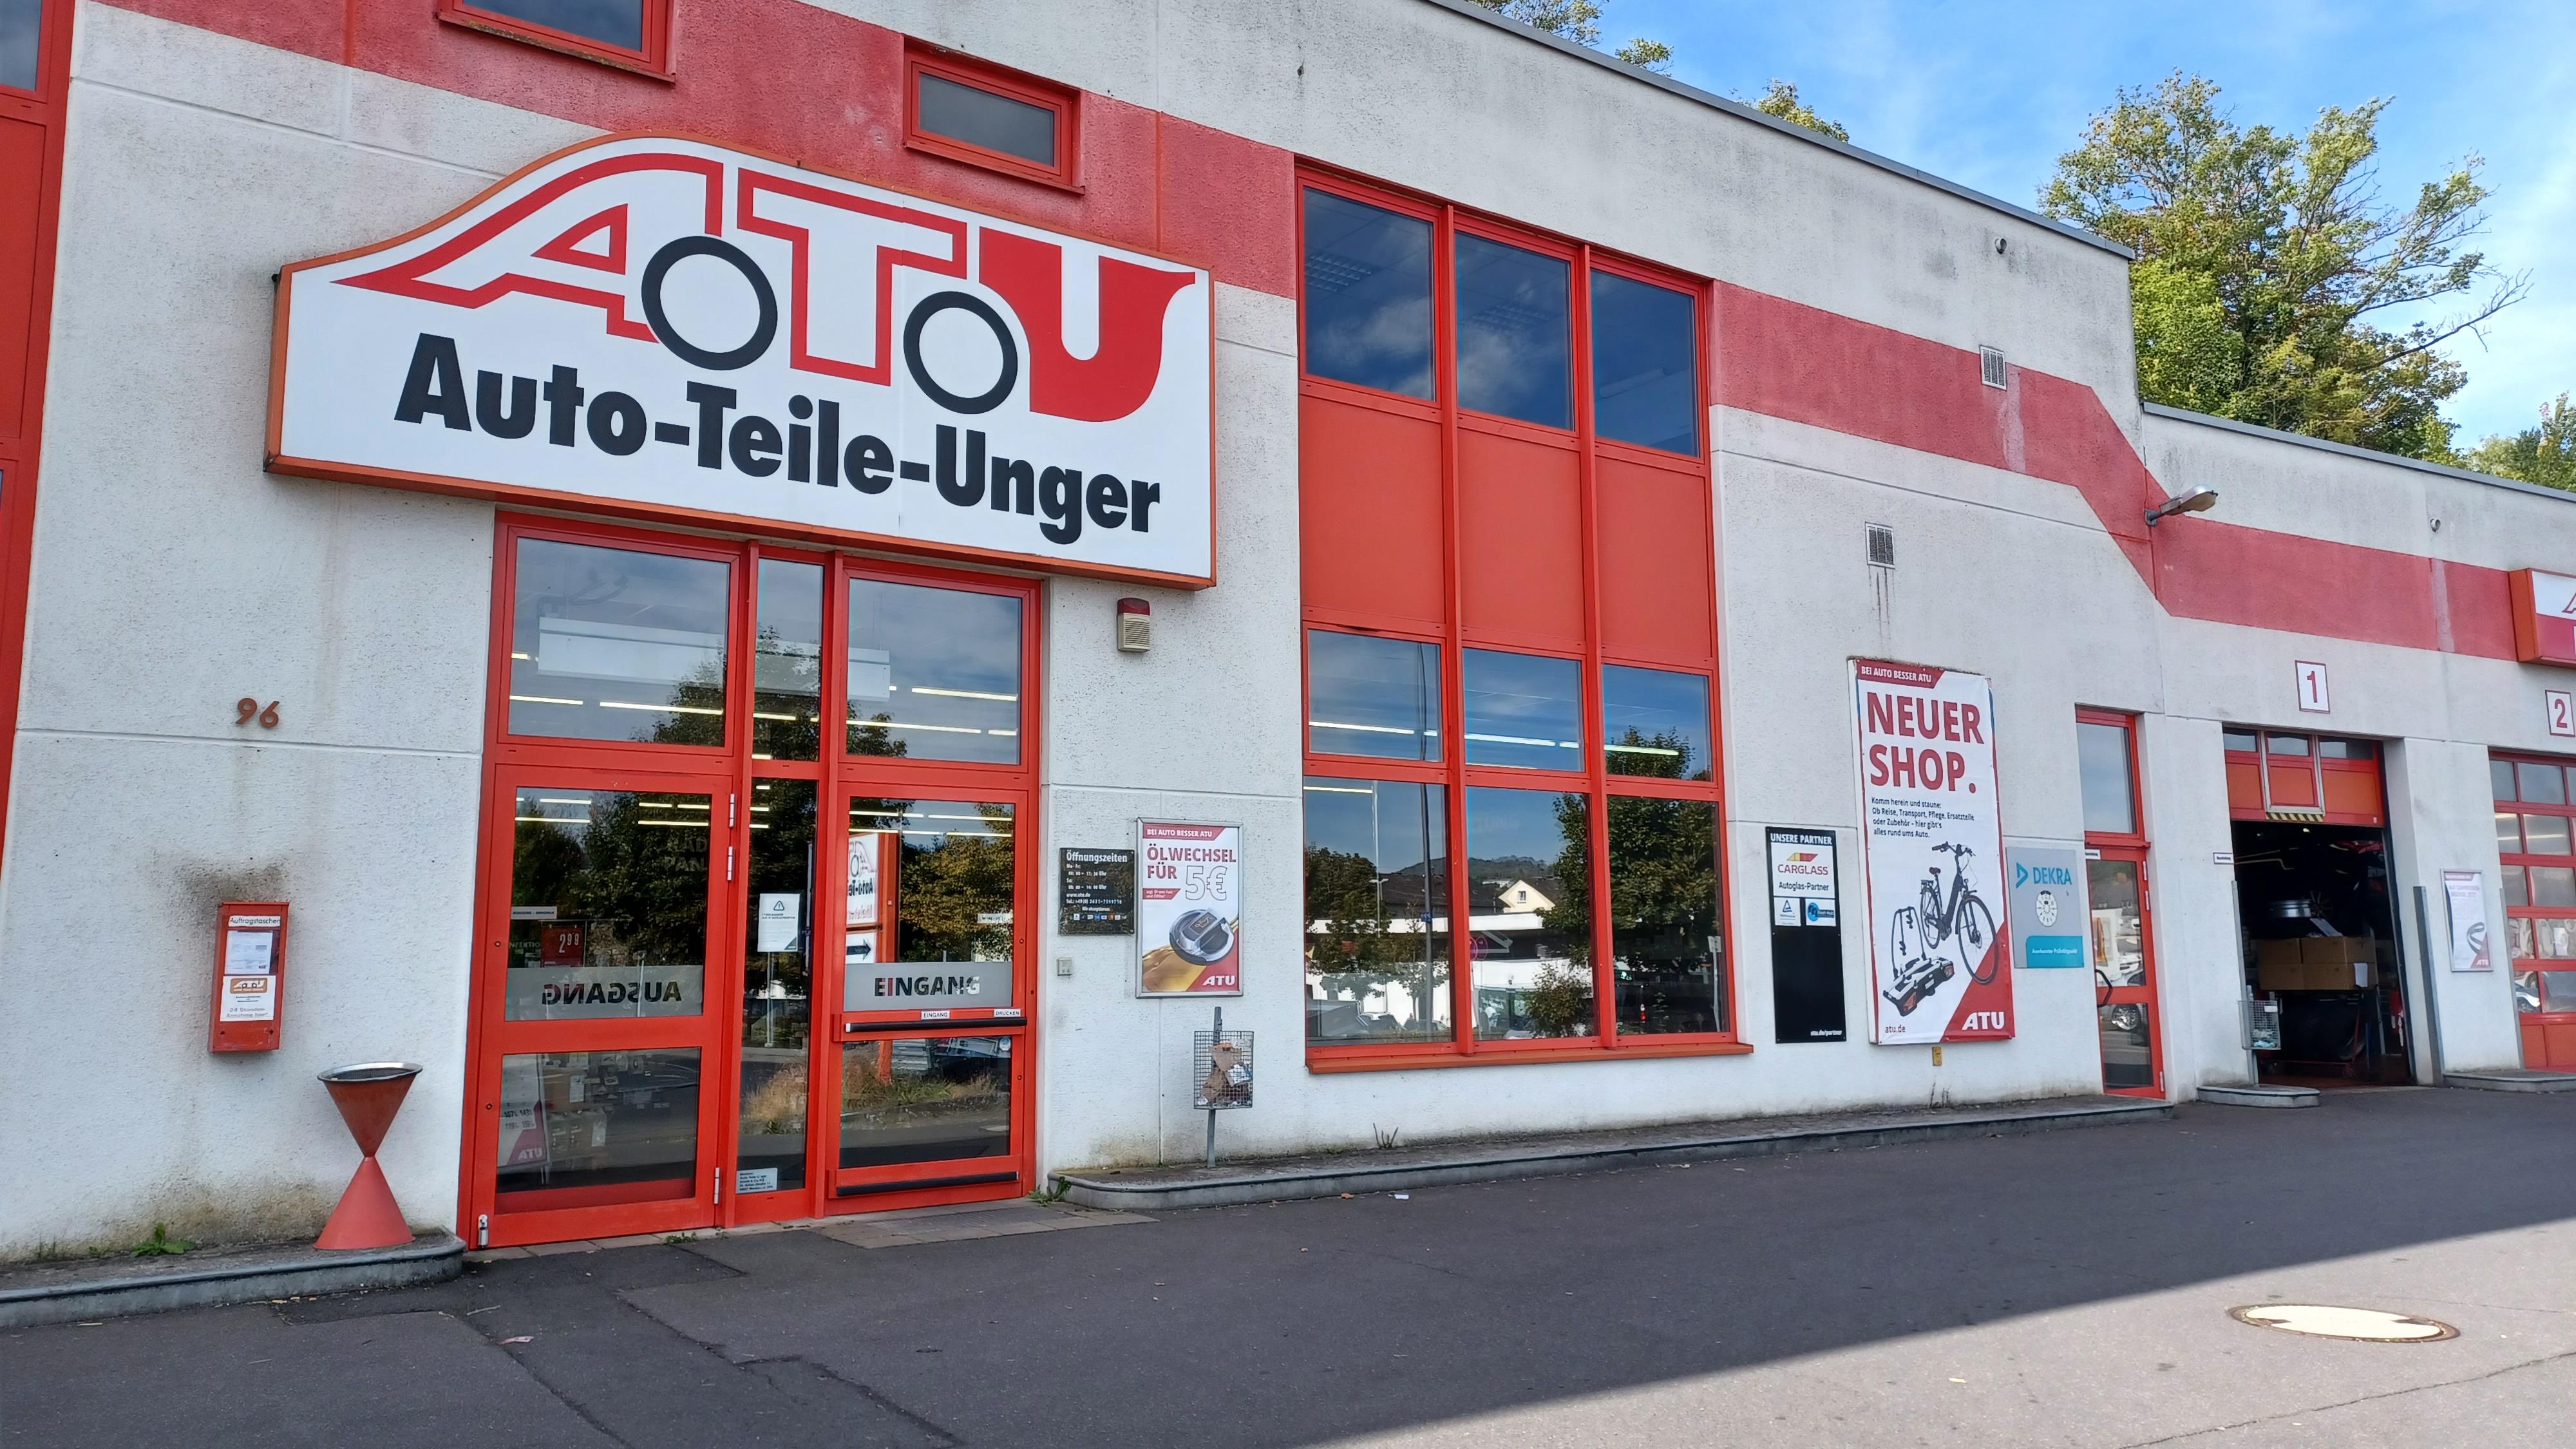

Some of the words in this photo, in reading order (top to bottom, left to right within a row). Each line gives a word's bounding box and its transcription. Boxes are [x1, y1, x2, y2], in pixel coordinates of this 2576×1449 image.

[394, 332, 1160, 545] Auto-Teile-Unger
[1861, 666, 1871, 675] BEI
[1873, 669, 1892, 677] AUTO
[1893, 672, 1917, 681] BESSER
[1918, 674, 1931, 683] ATU
[2307, 671, 2318, 703] 1
[235, 697, 279, 728] 96
[1868, 692, 1984, 744] NEUER
[2555, 699, 2568, 728] 2
[1870, 744, 1976, 793] SHOP.
[1882, 808, 1899, 817] Reise,
[1899, 809, 1927, 818] Transport,
[1947, 812, 1975, 821] Ersatzteile
[1887, 819, 1910, 827] Zubehör
[1770, 833, 1799, 843] UNSERE
[1799, 835, 1833, 845] PARTNER
[1873, 828, 1887, 836] alles
[1066, 849, 1128, 864] Öffnungszeiten
[1147, 843, 1236, 862] ÖLWECHSEL
[1777, 864, 1829, 875] CARGLASS
[2033, 867, 2072, 885] DEKRA
[1147, 862, 1177, 879] FÜR
[1186, 866, 1227, 901] 5€
[1779, 881, 1829, 891] Autoglas-Partner
[875, 976, 980, 997] EINGANG
[1202, 975, 1235, 986] ATU
[1885, 1025, 1906, 1033] atu.de
[1962, 1011, 2005, 1030] ATU
[518, 1147, 543, 1161] ATU
